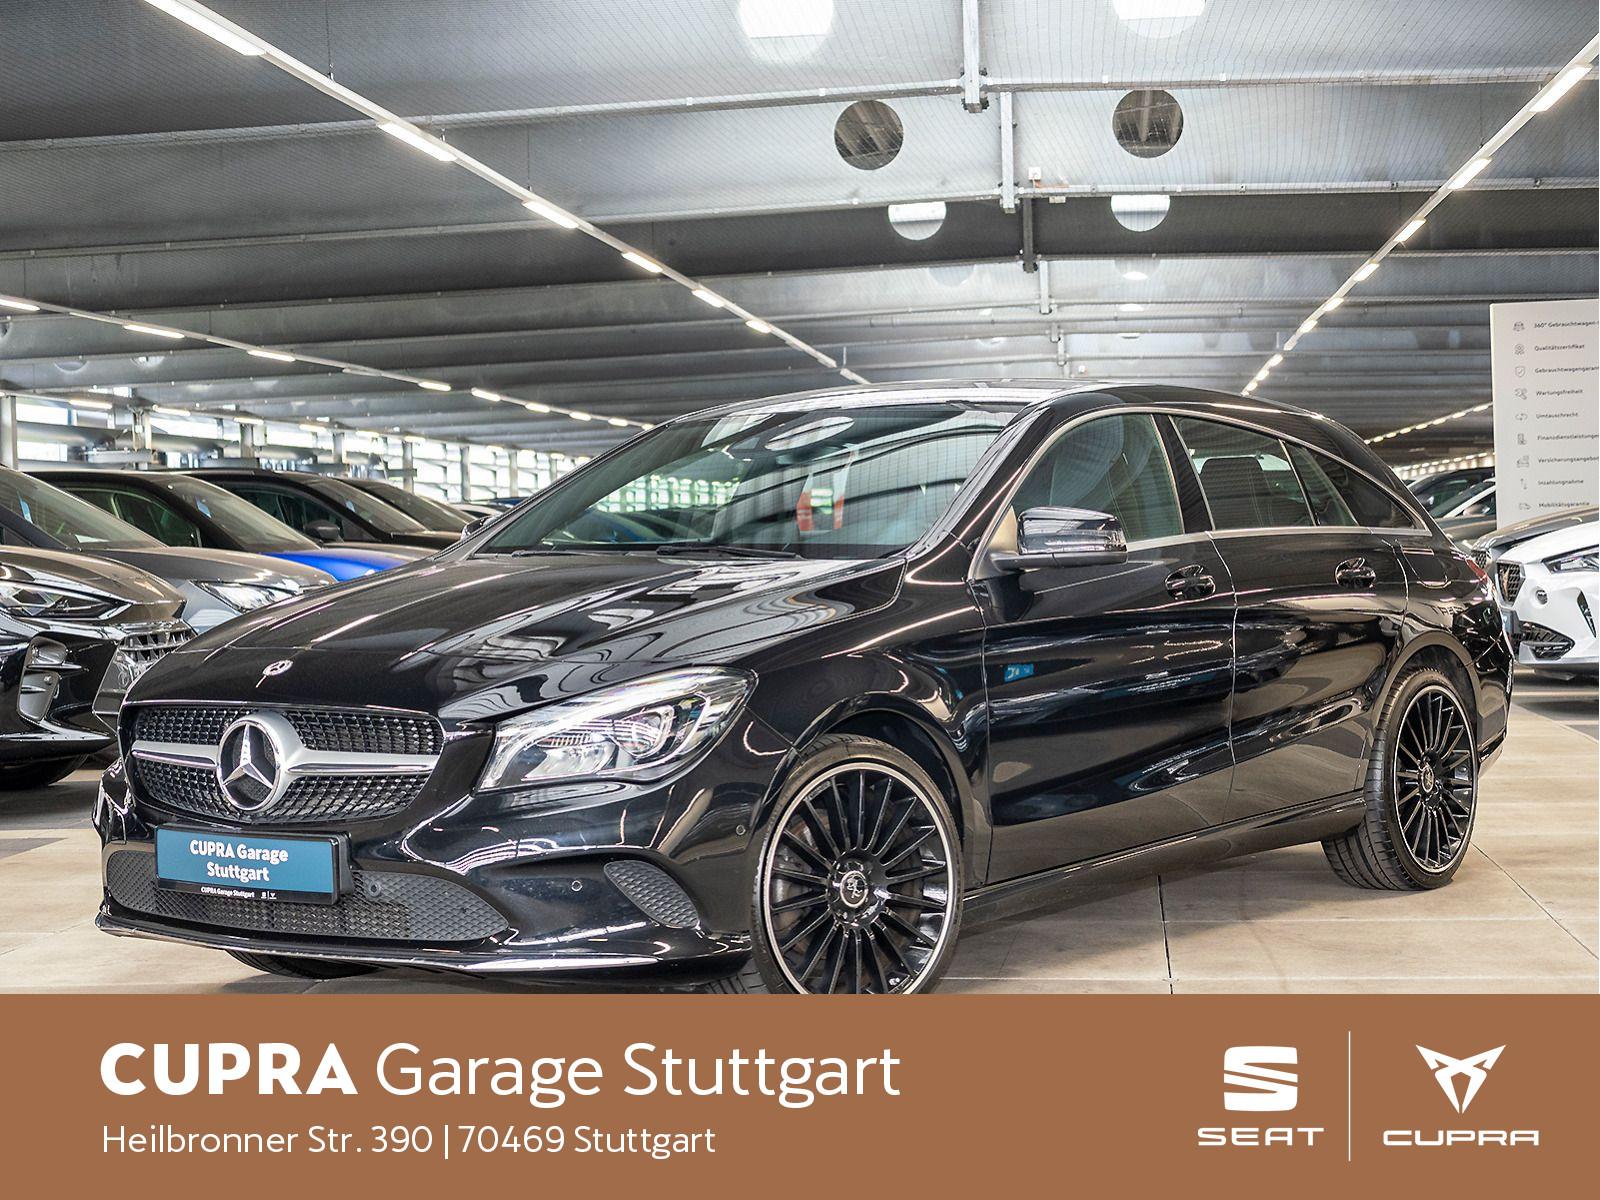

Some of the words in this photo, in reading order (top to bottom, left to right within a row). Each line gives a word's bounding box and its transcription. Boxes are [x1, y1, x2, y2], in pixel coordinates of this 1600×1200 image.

[1548, 320, 1599, 328] Gebrauchtwagen-
[189, 839, 236, 859] CUPRA
[236, 844, 289, 865] Garage
[206, 861, 270, 883] Stuttgart
[200, 886, 217, 895] CUPRA
[216, 887, 233, 897] Garage
[232, 889, 255, 899] Stuttgart
